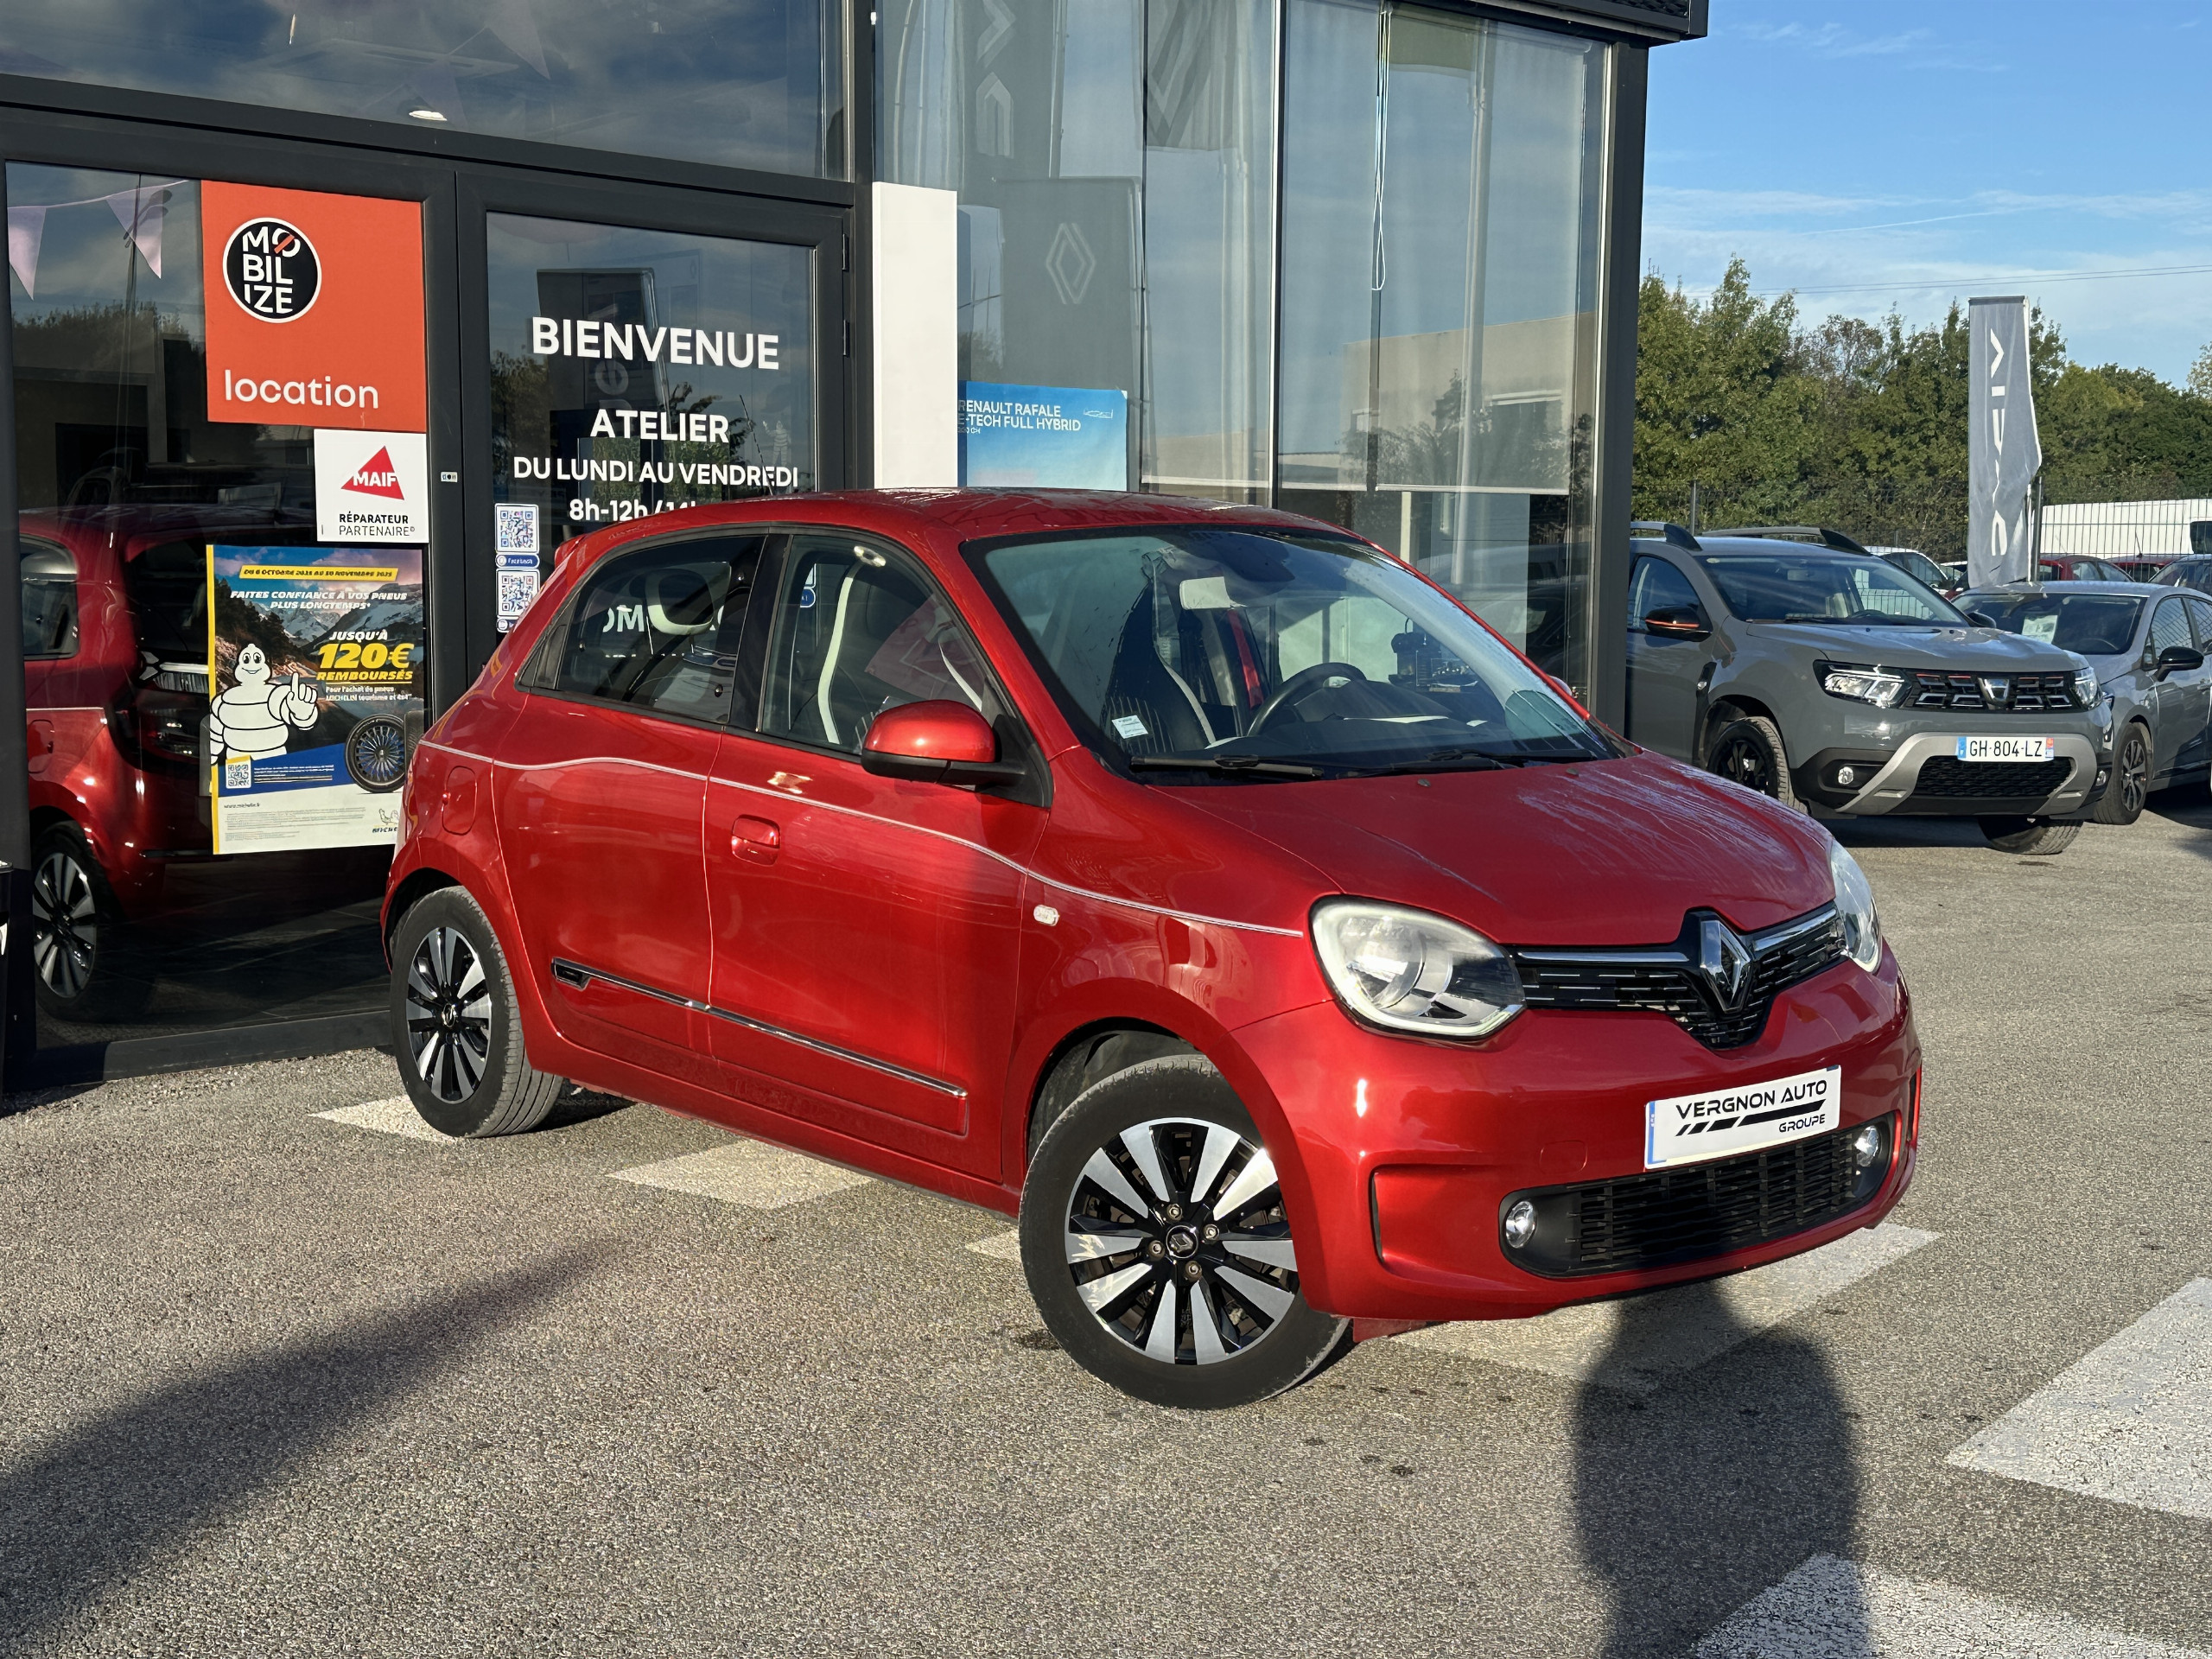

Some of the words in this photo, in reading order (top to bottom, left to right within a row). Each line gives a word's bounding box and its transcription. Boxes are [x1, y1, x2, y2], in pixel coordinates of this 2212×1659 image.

[531, 316, 779, 370] BIENVENUE
[225, 369, 378, 410] location
[958, 399, 1013, 415] RENAULT
[1014, 403, 1061, 417] RAFALE
[590, 408, 729, 443] ATELIER
[1003, 417, 1034, 429] FULL
[1036, 417, 1082, 431] HYBRID
[353, 471, 397, 487] MAIF
[513, 456, 550, 479] DU
[556, 459, 634, 482] LUNDI
[639, 461, 674, 484] AU
[678, 463, 798, 488] VENDREDI
[339, 511, 409, 524] RÉPARATEUR
[271, 591, 334, 600] CONFIANCE
[336, 588, 345, 599] À
[347, 591, 370, 600] VOS
[371, 592, 407, 601] PNEUS
[329, 629, 388, 643] JUSQU'À
[318, 642, 415, 669] 120€
[316, 669, 413, 681] REMBOURSÉS
[1969, 740, 2043, 757] GH-804-LZ
[1675, 1090, 1776, 1120] VERGNON
[1780, 1079, 1827, 1104] AUTO
[1778, 1114, 1826, 1133] GROUPE
